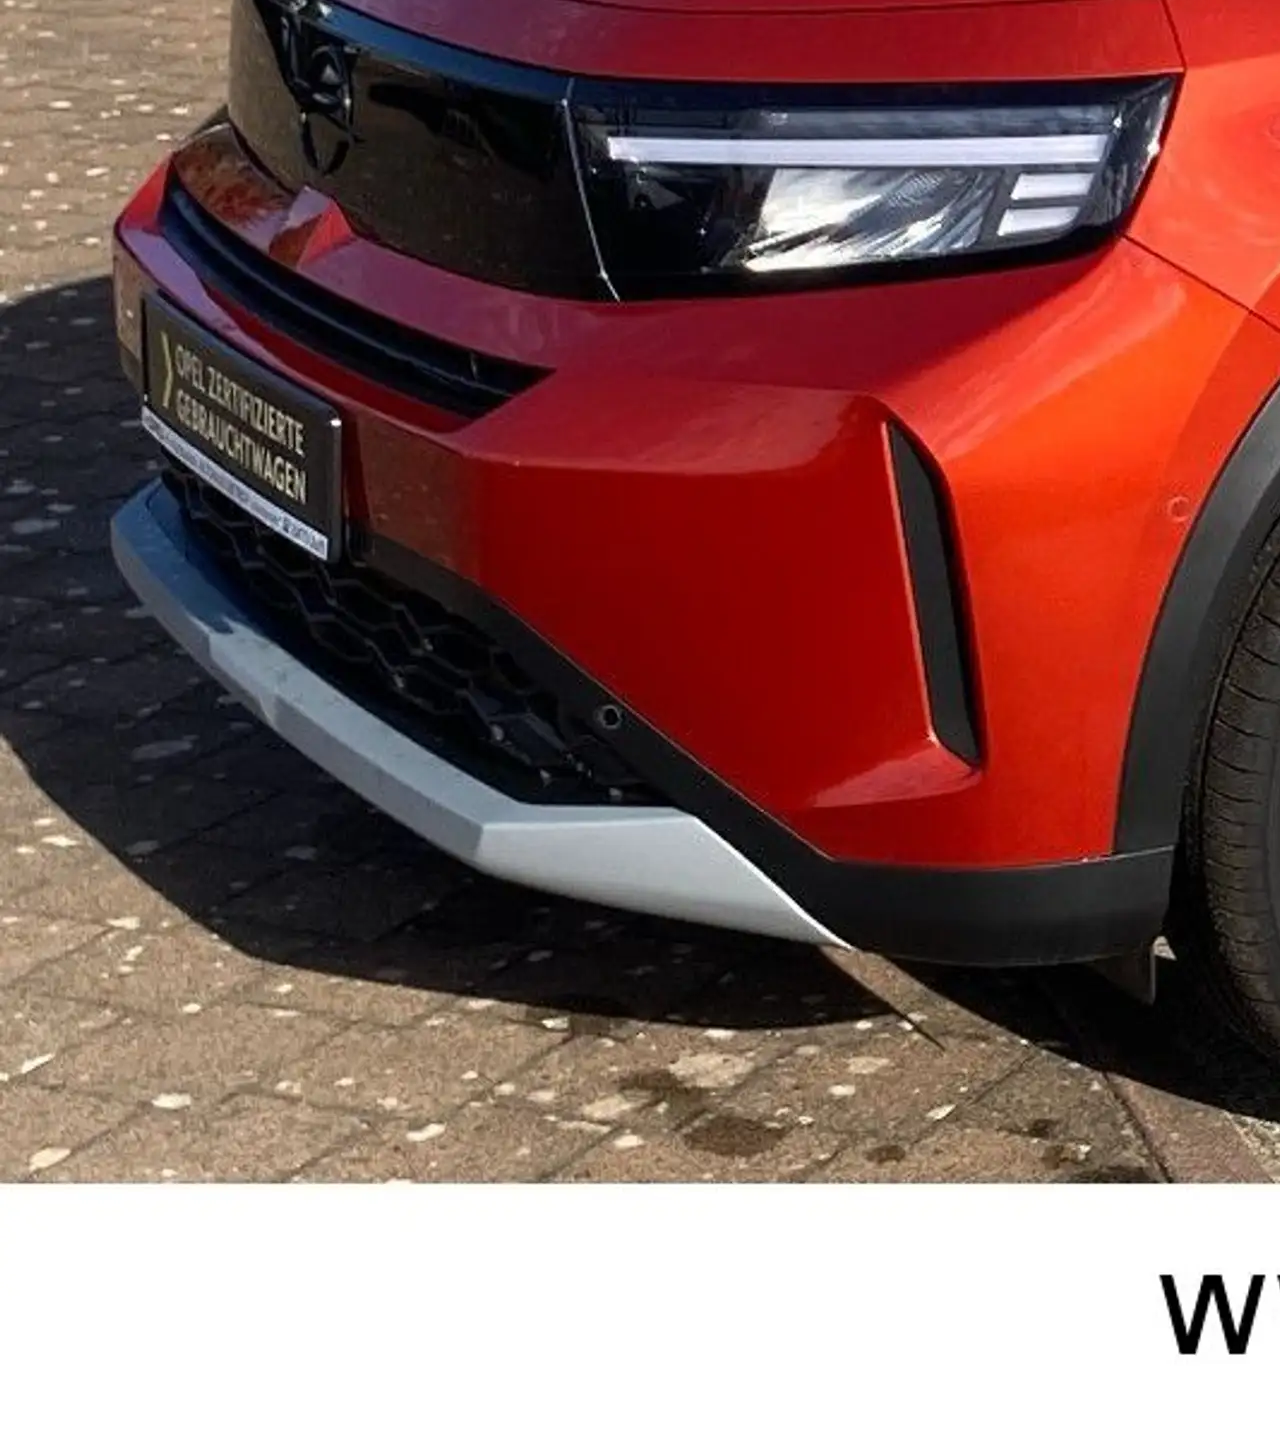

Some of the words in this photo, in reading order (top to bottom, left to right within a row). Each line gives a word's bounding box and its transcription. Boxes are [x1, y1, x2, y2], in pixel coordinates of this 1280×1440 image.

[175, 344, 206, 393] OPEL
[208, 366, 306, 457] ZERTIFIZIERTE
[176, 389, 307, 504] GEBRAUCHTWAGEN
